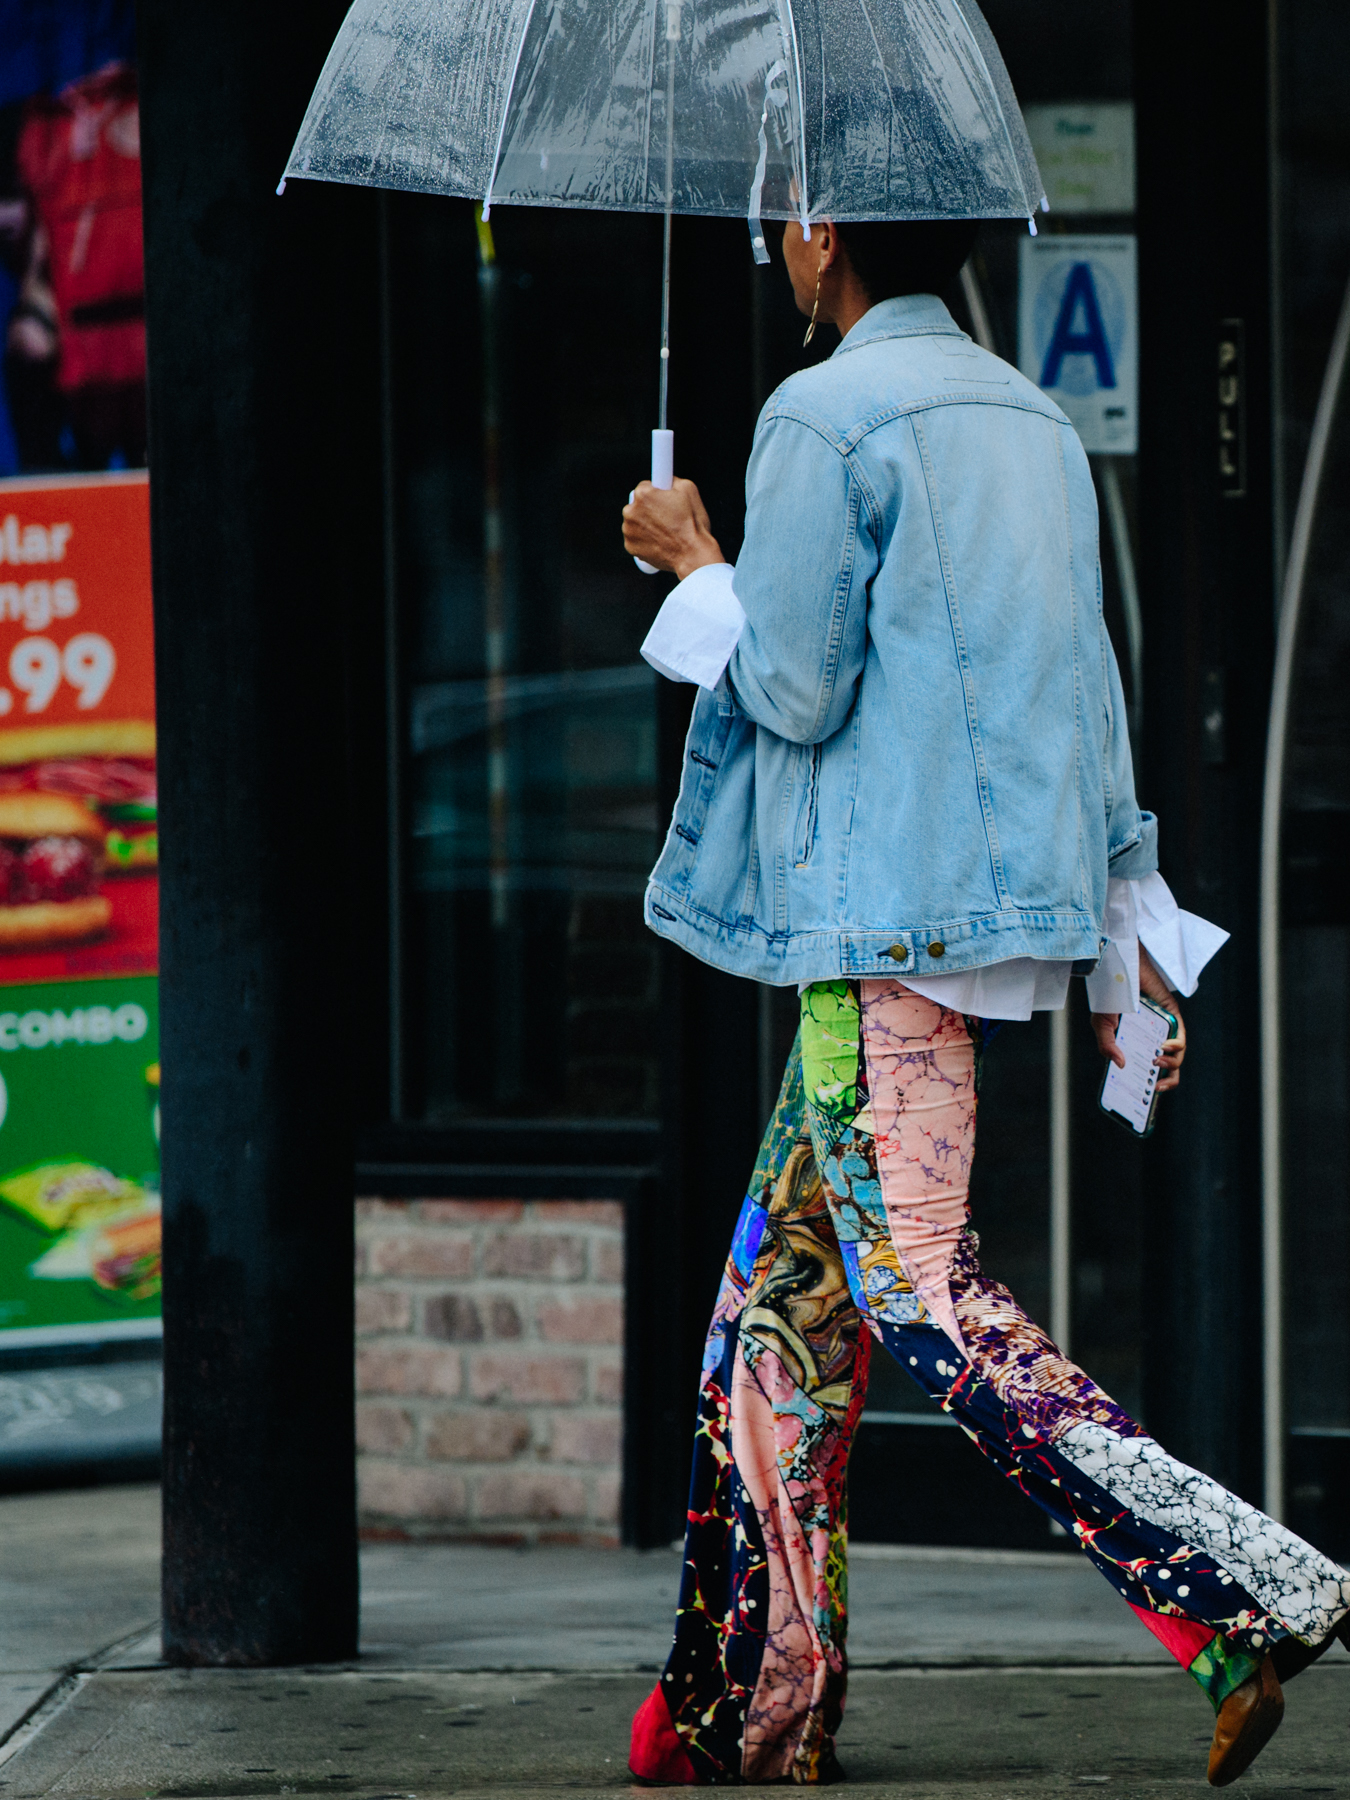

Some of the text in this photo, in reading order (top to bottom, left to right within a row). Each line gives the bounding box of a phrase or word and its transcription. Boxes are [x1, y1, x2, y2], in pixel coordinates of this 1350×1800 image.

[1039, 261, 1118, 389] A
[1218, 340, 1238, 476] PULL
[0, 513, 74, 566] lar
[0, 1002, 149, 1052] COMBO
